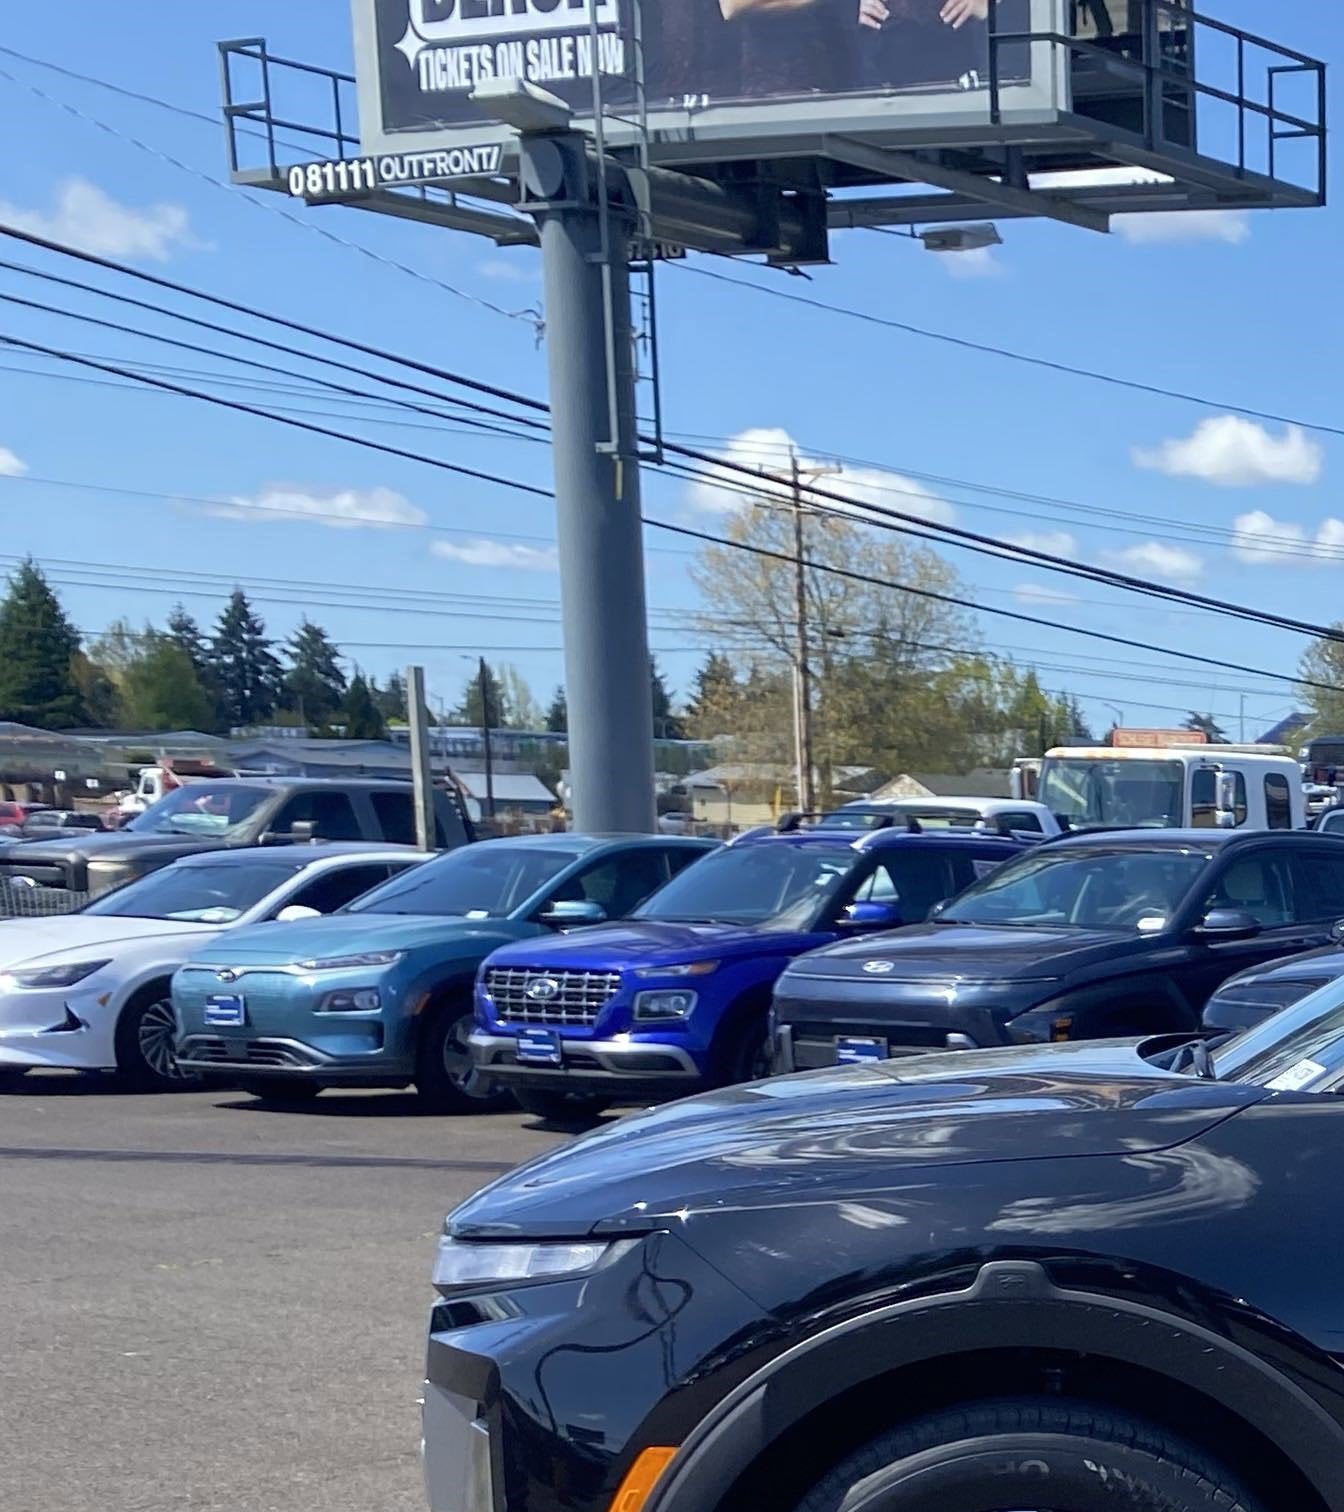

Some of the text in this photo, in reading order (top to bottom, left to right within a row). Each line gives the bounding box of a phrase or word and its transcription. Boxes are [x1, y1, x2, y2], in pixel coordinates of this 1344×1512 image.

[418, 43, 495, 91] TICKETS
[495, 40, 525, 79] ON
[526, 35, 577, 81] SALE
[288, 158, 376, 196] 081111
